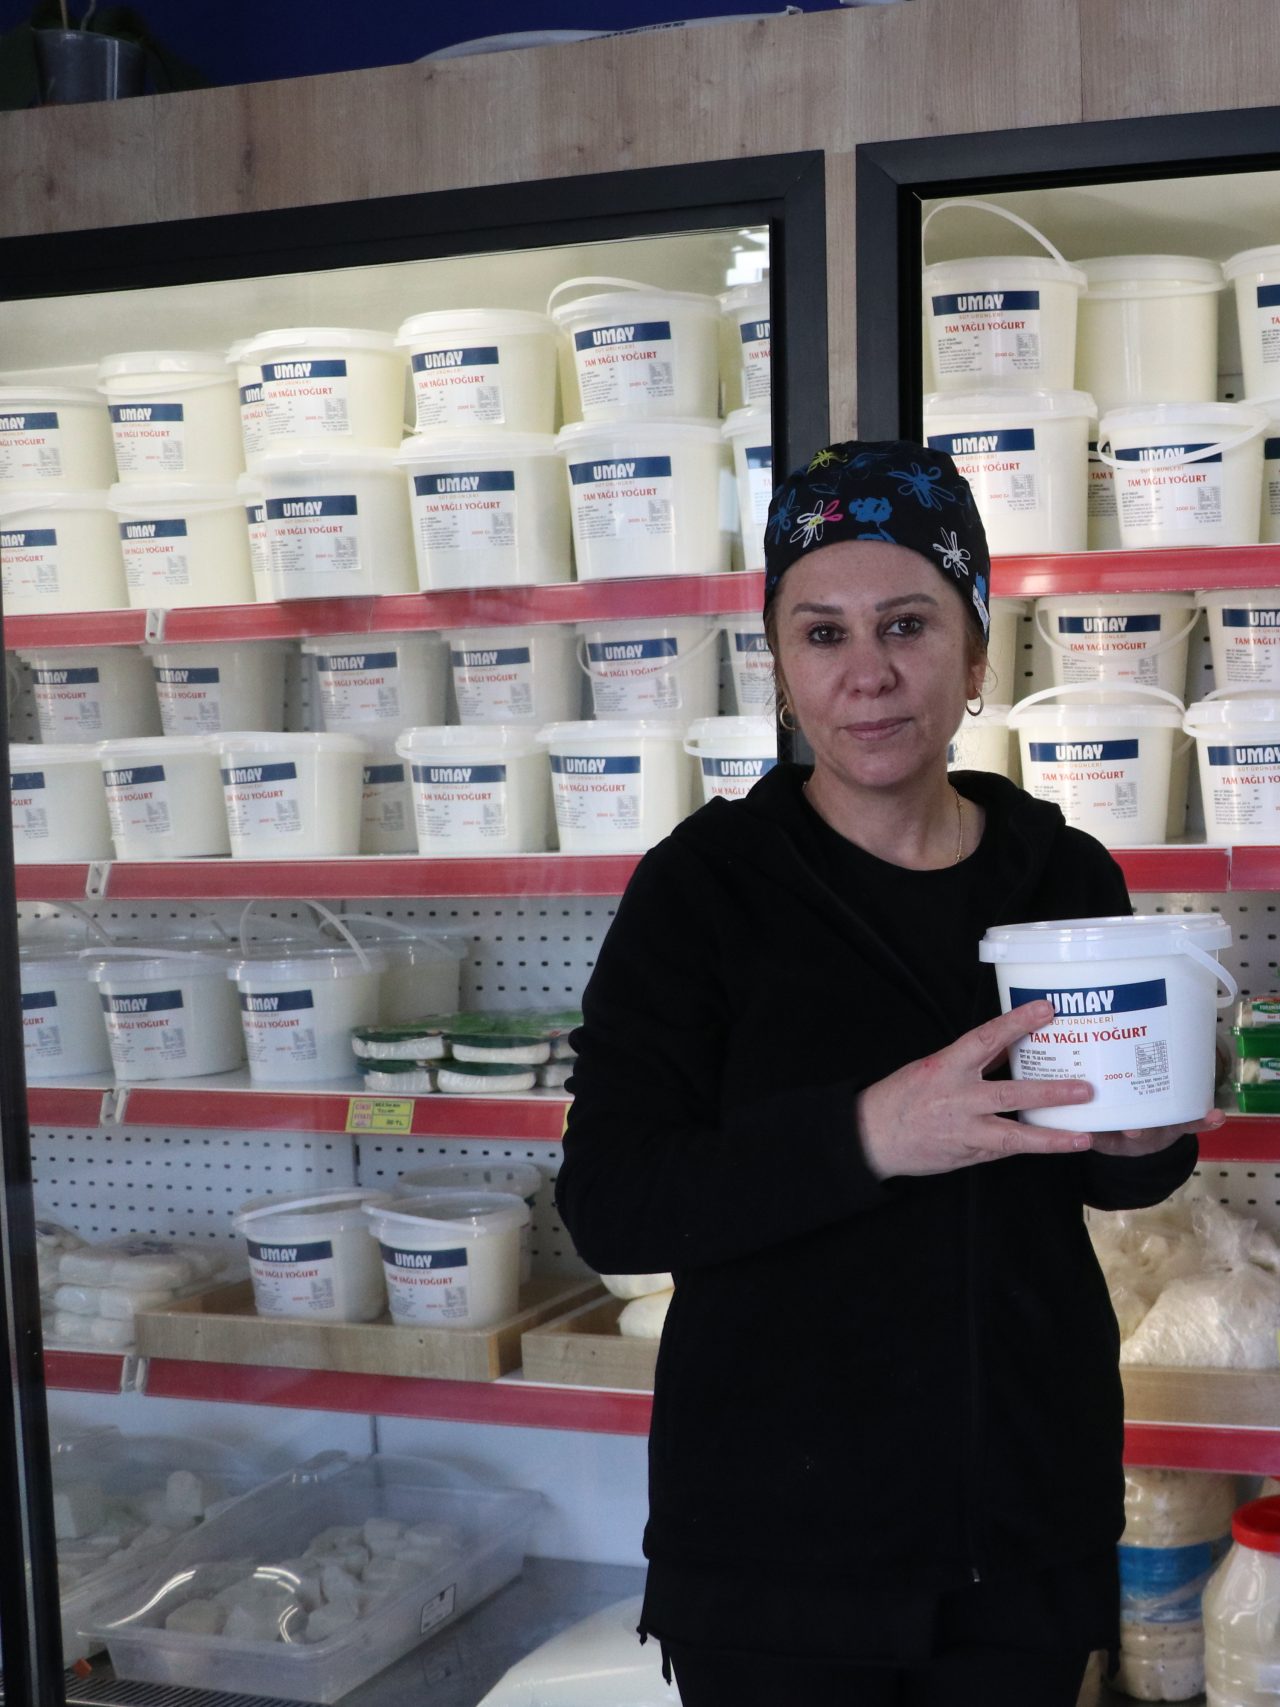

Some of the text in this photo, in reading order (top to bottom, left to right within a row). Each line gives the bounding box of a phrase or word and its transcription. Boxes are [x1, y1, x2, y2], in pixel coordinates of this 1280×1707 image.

[957, 294, 1004, 310] UMAY
[593, 327, 635, 345] UMAY
[425, 351, 463, 368] UMAY
[274, 363, 312, 379] UMAY
[120, 408, 152, 421] UMAY
[952, 436, 998, 453] UMAY
[593, 463, 635, 480] UMAY
[437, 477, 479, 491] UMAY
[283, 502, 322, 516] UMAY
[127, 525, 156, 538] UMAY
[1083, 617, 1127, 632] UMAY
[464, 652, 498, 665] UMAY
[605, 645, 643, 659] UMAY
[331, 656, 365, 670] UMAY
[1055, 744, 1103, 760] UMAY
[567, 758, 605, 772] UMAY
[721, 761, 762, 775] UMAY
[431, 768, 471, 782] UMAY
[1046, 990, 1114, 1014] UMAY
[1068, 1017, 1114, 1025] ÜRÜNLERİ
[1029, 1026, 1148, 1043] TAM YAĞLI YOĞURT
[260, 1247, 297, 1262] UMAY
[395, 1253, 432, 1267] UMAY
